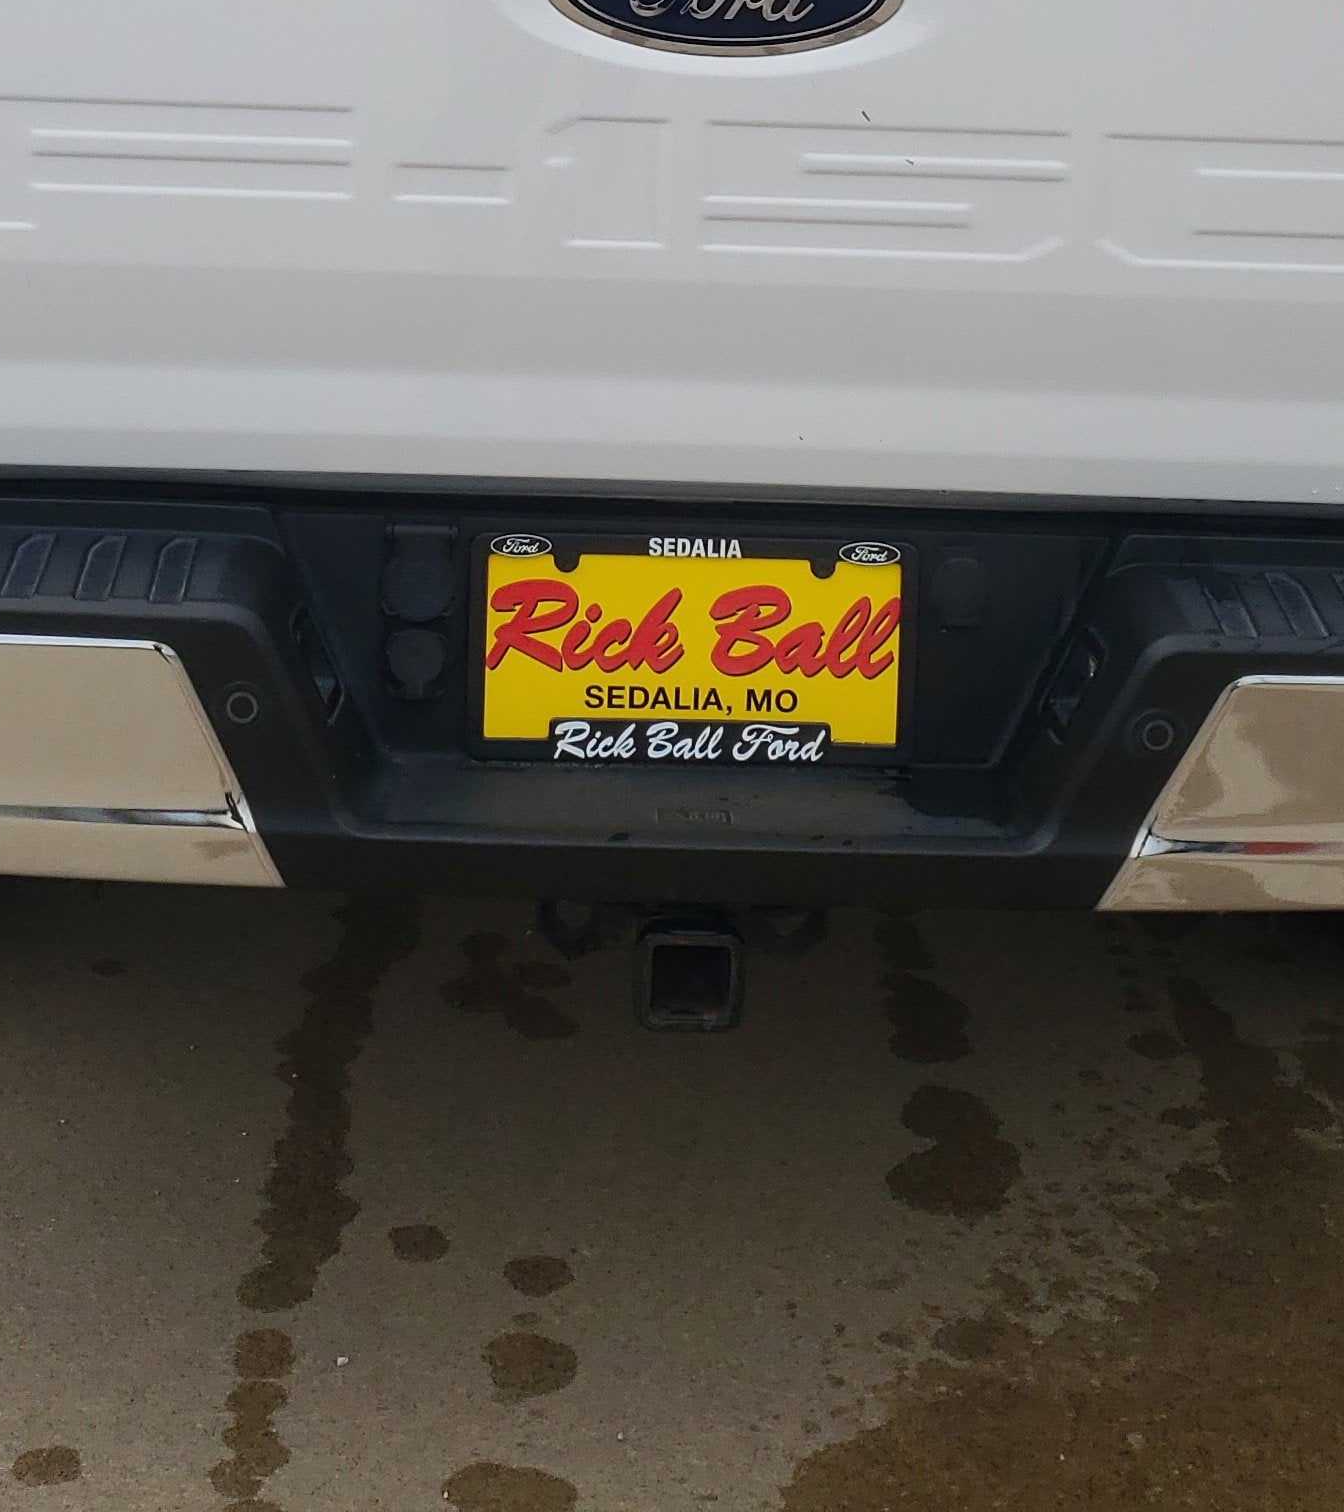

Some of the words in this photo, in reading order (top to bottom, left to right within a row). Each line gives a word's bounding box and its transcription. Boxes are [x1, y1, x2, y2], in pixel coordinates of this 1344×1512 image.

[502, 538, 540, 553] Ford
[648, 536, 742, 559] SEDALIA
[851, 546, 888, 561] Ford
[486, 578, 685, 675] Rick
[709, 585, 902, 680] Ball
[584, 684, 732, 716] SEDALIA,
[745, 687, 798, 713] MO
[554, 720, 638, 760] Rick
[646, 722, 723, 761] Ball
[731, 723, 827, 763] Ford
